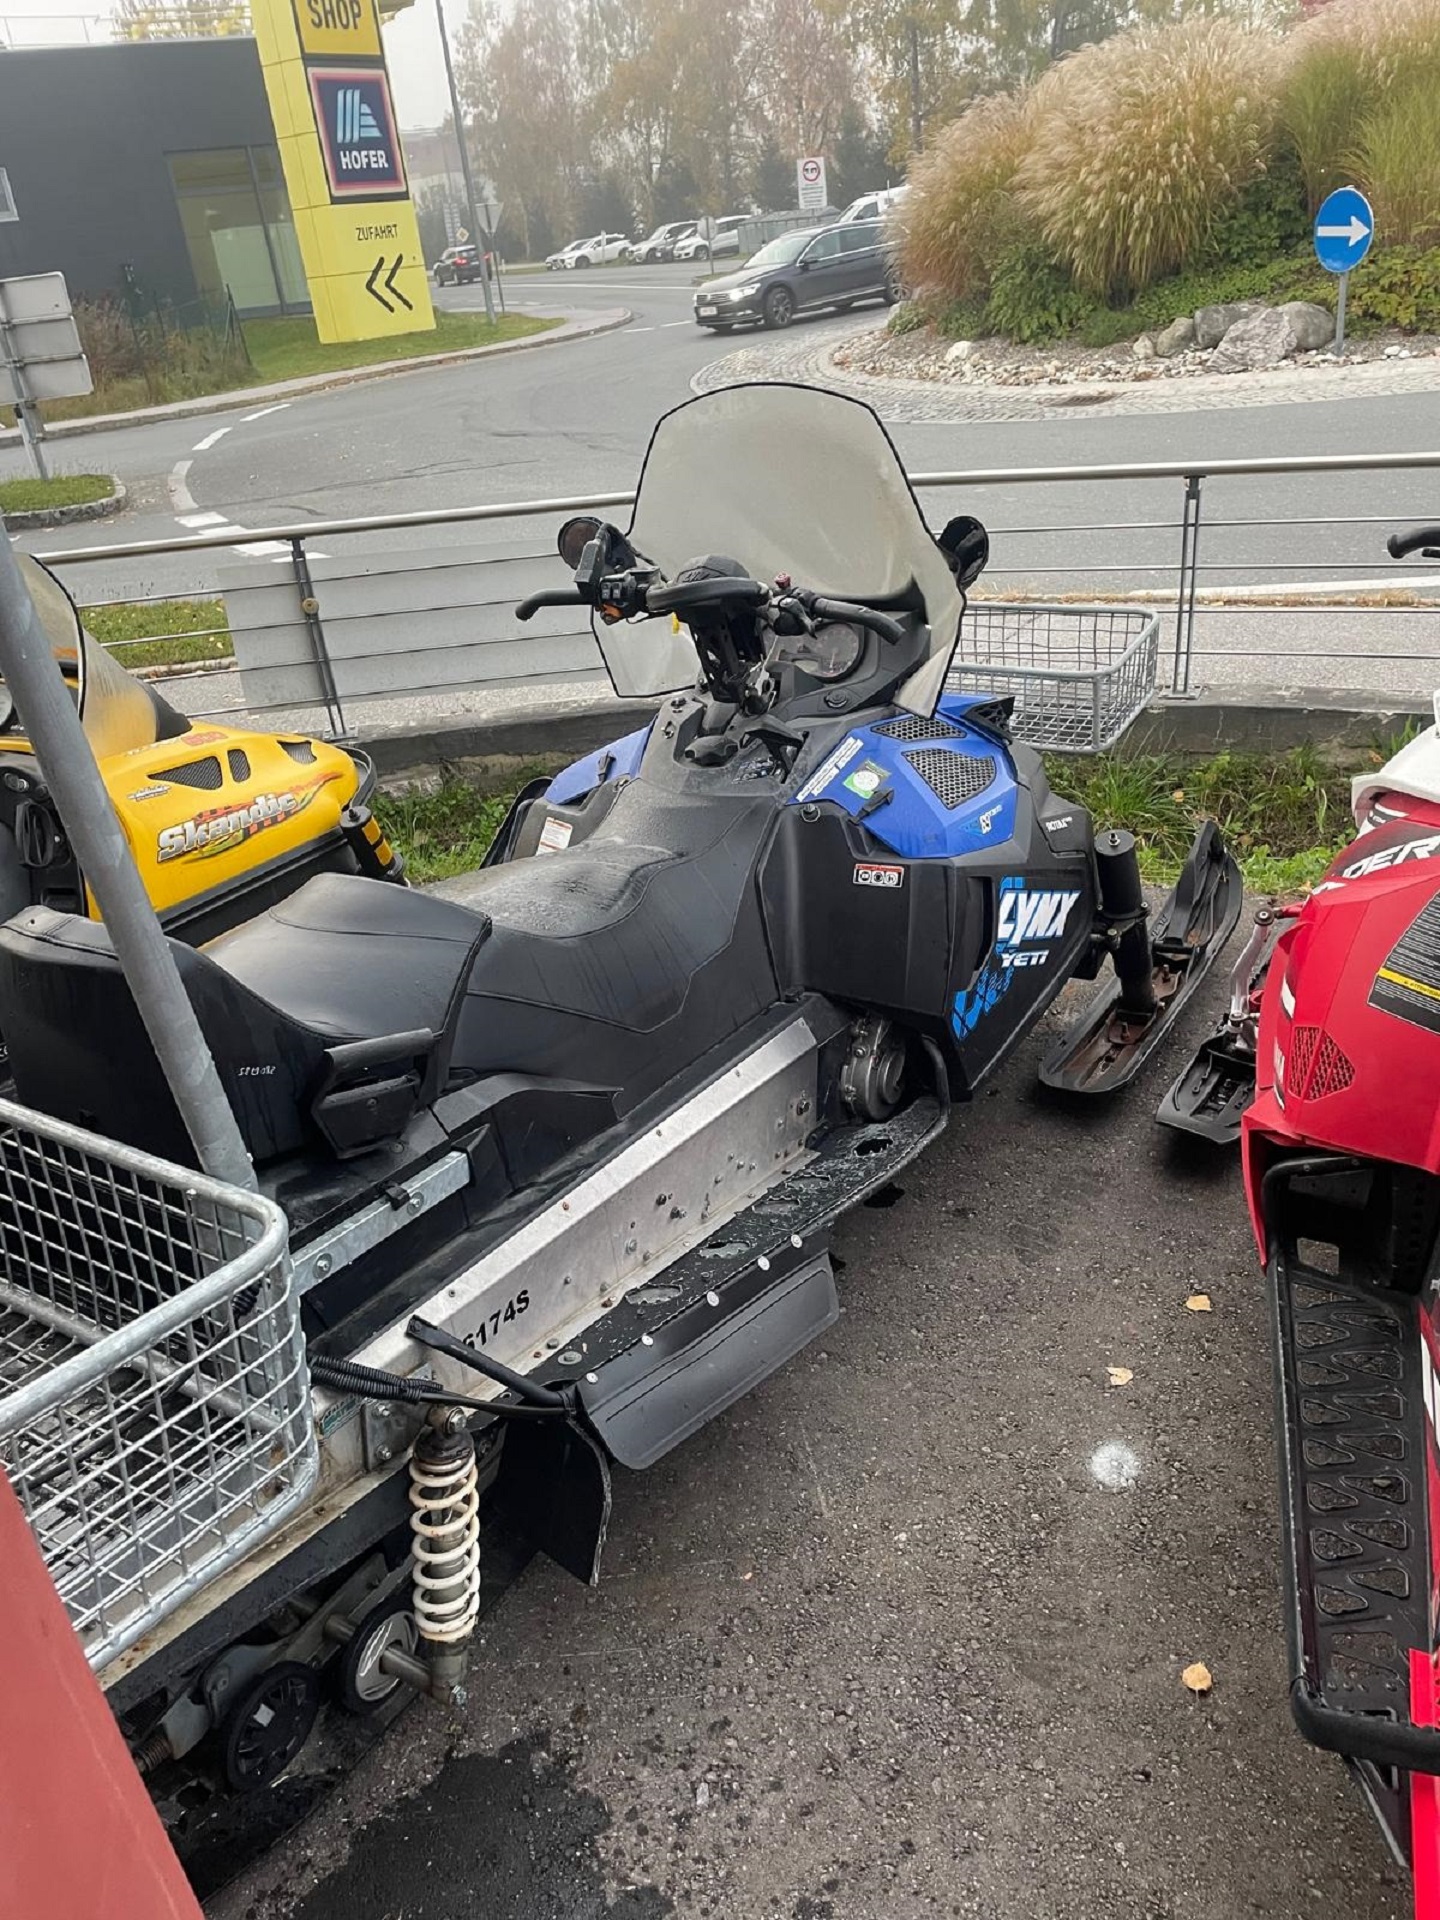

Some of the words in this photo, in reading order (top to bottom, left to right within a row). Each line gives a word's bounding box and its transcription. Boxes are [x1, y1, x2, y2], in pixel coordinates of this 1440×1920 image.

[307, 0, 362, 29] SHOP
[340, 149, 389, 170] HOFER
[355, 223, 398, 241] ZUFAHRT
[157, 792, 298, 864] Skandic
[997, 890, 1082, 948] LYNX
[1001, 950, 1050, 968] YETI
